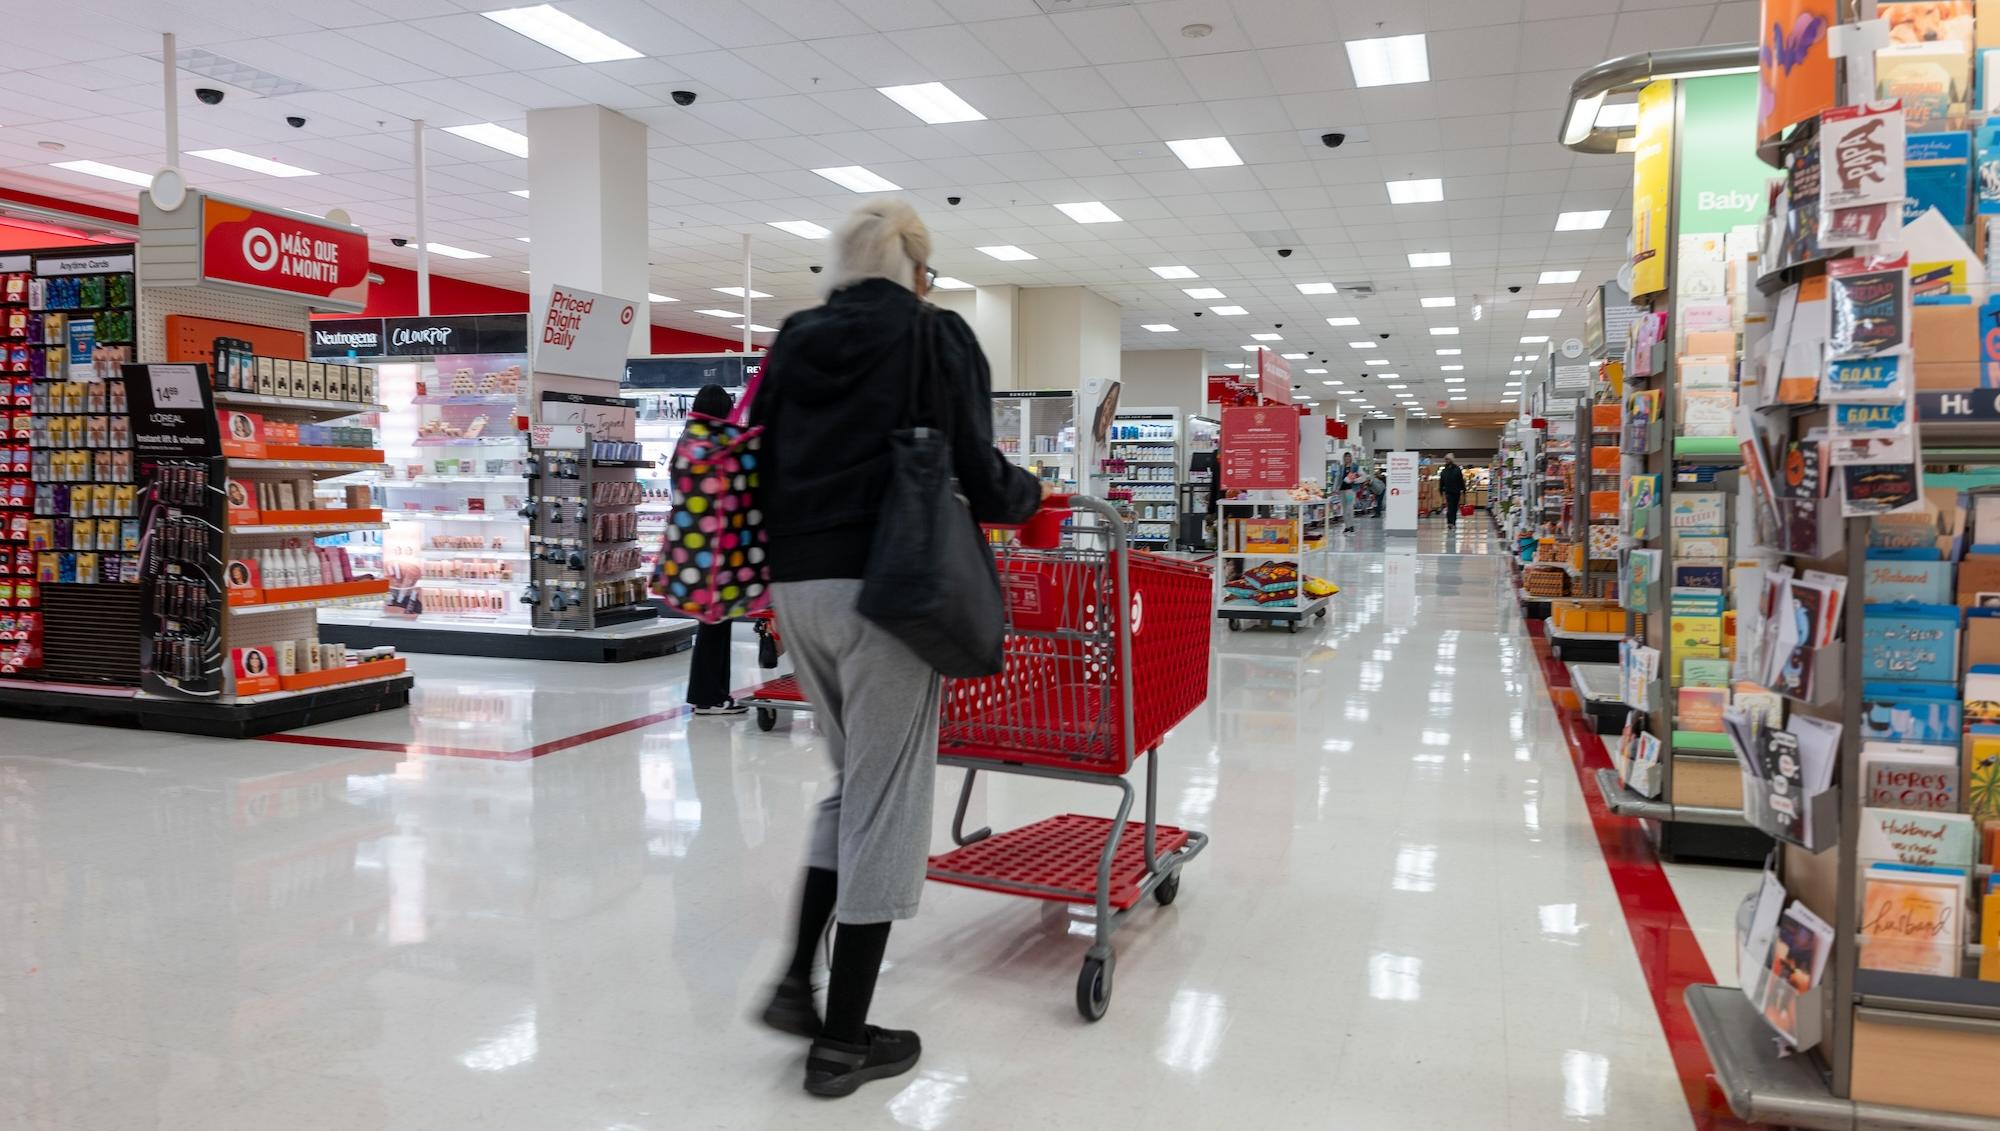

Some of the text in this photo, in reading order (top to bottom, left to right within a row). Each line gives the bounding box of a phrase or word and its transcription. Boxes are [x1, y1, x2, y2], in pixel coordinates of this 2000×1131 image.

[1838, 132, 1874, 181] PAPA
[1698, 190, 1759, 213] Baby
[1842, 213, 1872, 235] #1
[280, 231, 338, 263] MÁS QUE
[60, 260, 109, 271] Anytime Cards
[281, 255, 338, 284] A MONTH
[551, 291, 594, 314] Priced
[547, 309, 581, 332] Right
[315, 330, 377, 347] Neutrogena
[392, 327, 452, 346] COLOURPOP
[544, 327, 575, 350] Daily
[136, 434, 161, 443] Instant
[179, 435, 205, 445] volume
[1881, 819, 1947, 840] Husband
[1861, 900, 1952, 936] husband
